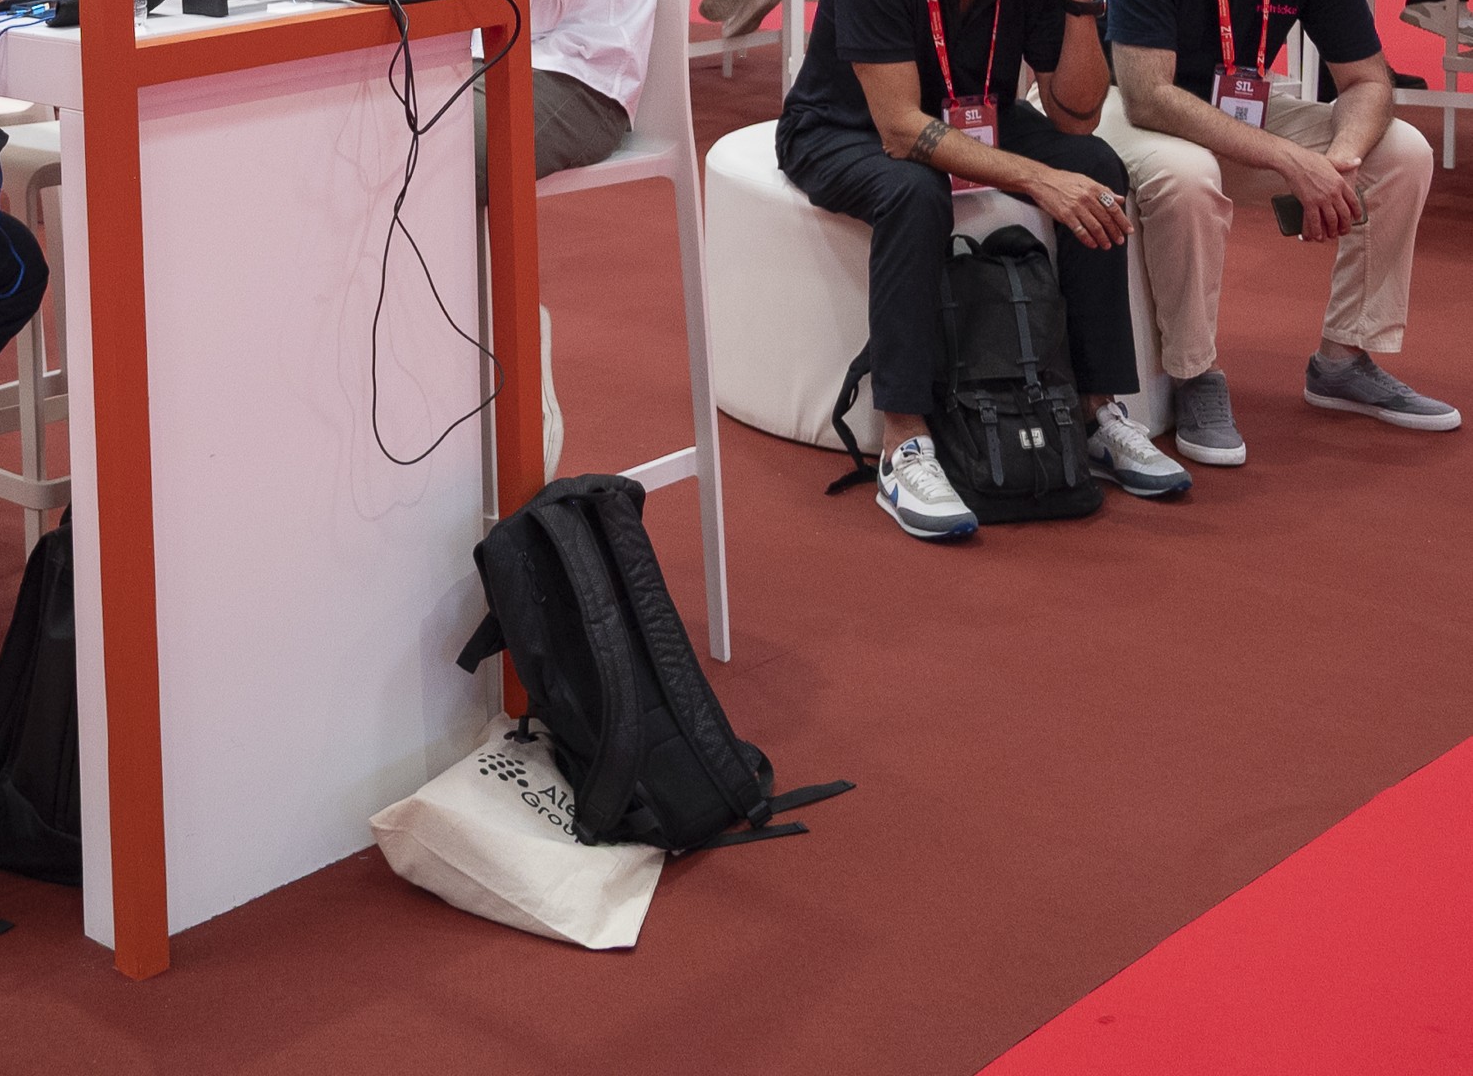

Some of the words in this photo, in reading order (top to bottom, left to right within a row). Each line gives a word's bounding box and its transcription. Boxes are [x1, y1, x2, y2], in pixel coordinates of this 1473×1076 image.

[1220, 25, 1232, 38] ZF
[1235, 80, 1254, 92] SIL
[965, 109, 982, 121] SIL
[538, 785, 575, 818] Ale
[521, 792, 579, 843] Grou
